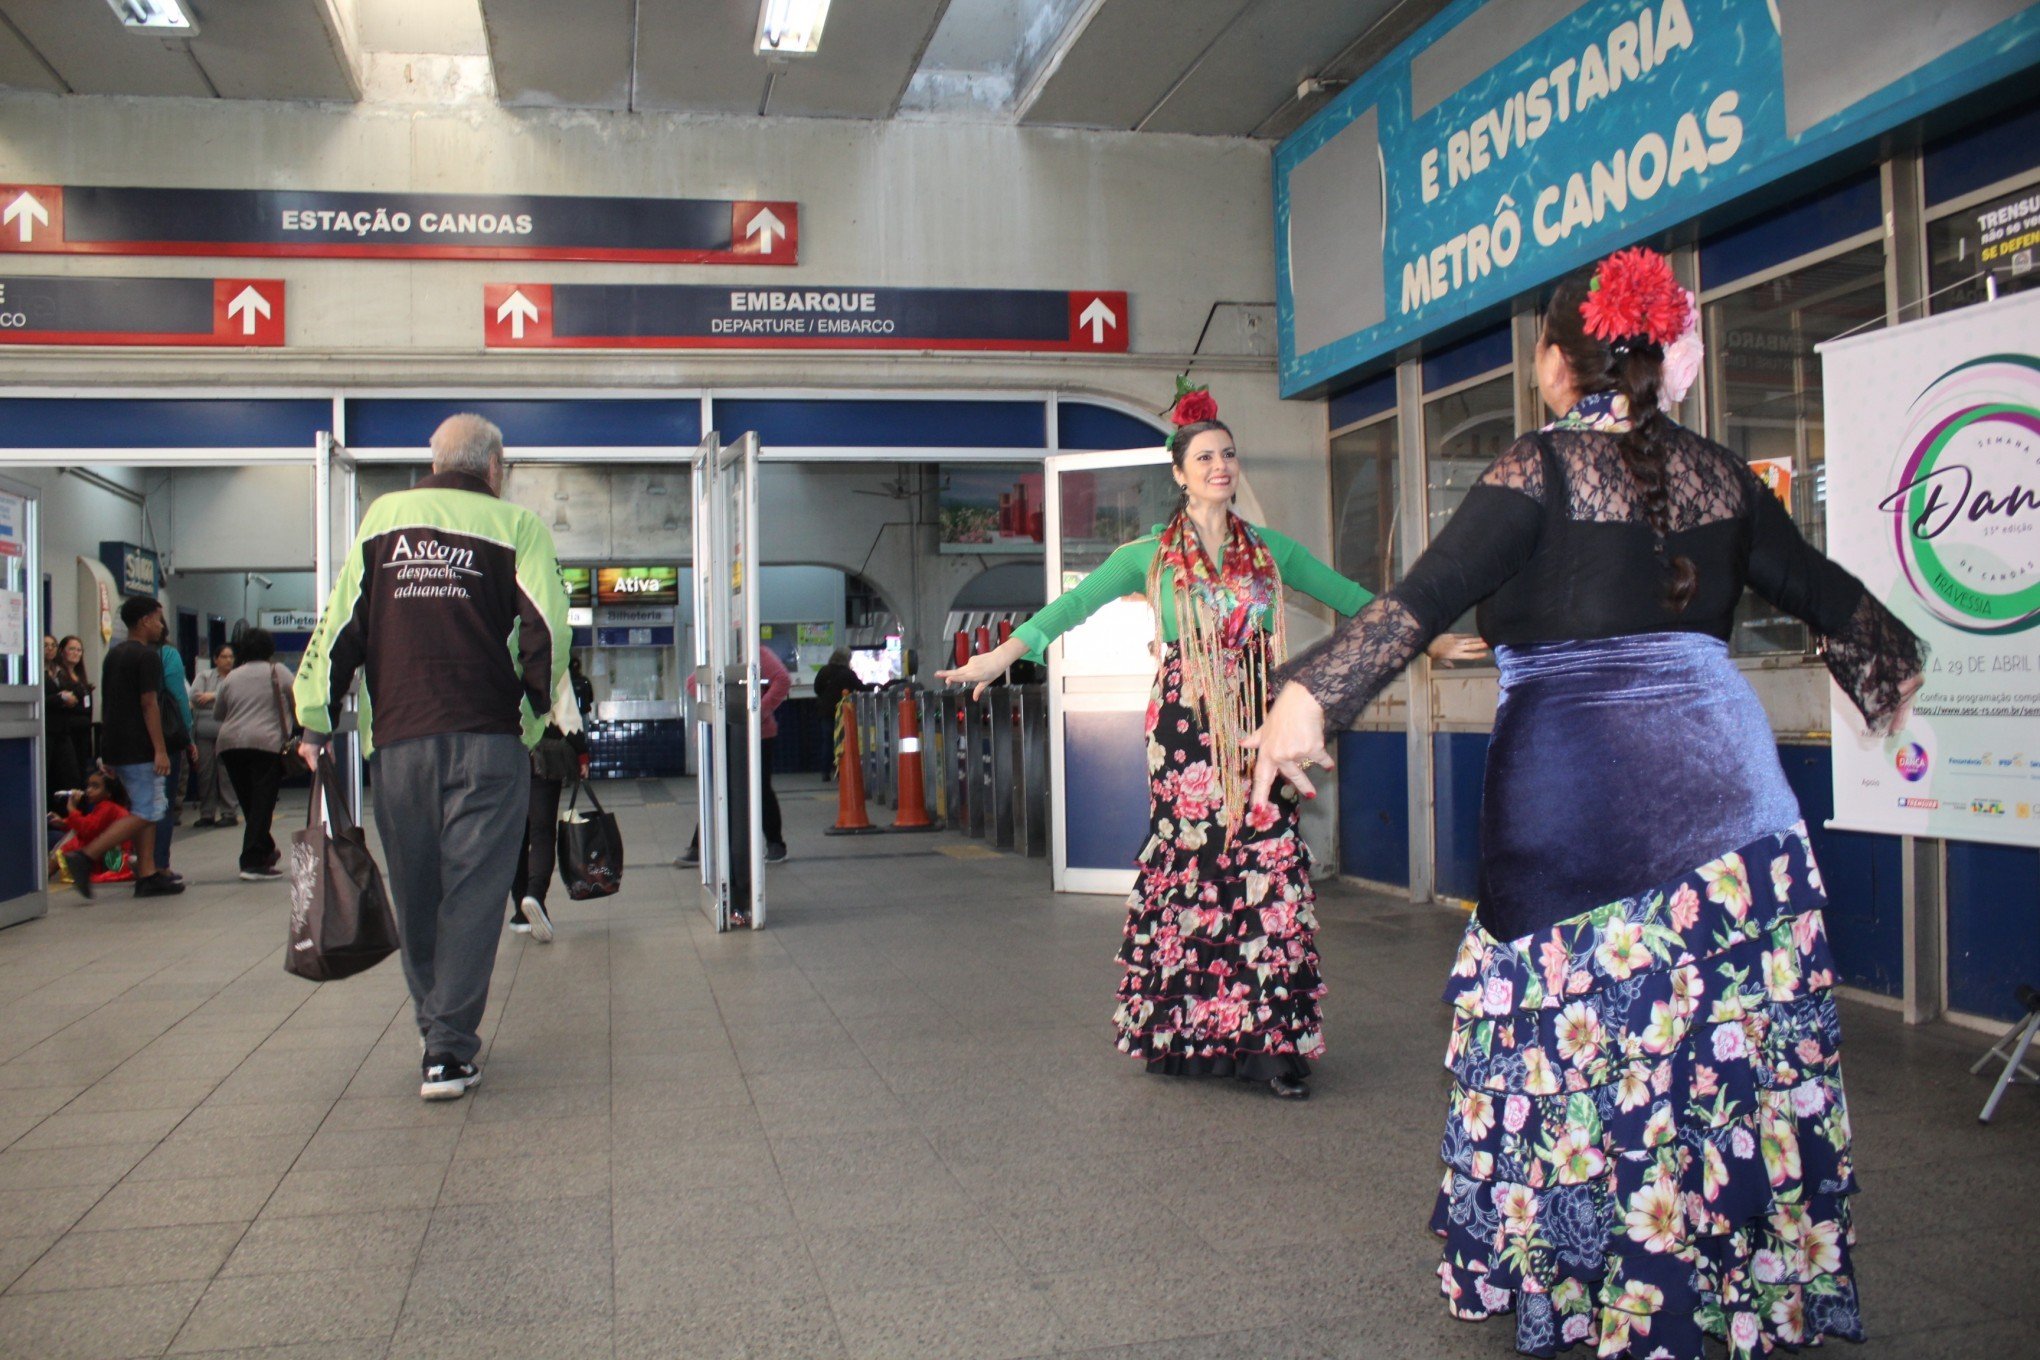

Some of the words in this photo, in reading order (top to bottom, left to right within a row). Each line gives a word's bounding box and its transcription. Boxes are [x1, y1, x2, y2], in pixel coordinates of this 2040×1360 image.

[1420, 148, 1440, 203] E
[1447, 0, 1695, 188] REVISTARIA
[1401, 194, 1522, 314] METRÔ
[1532, 90, 1744, 247] CANOAS
[282, 208, 411, 236] ESTAÇÃO
[419, 213, 533, 234] CANOAS
[1977, 195, 2040, 231] TRENSU
[1981, 245, 1998, 261] SE
[731, 292, 876, 313] EMBARQUE
[711, 319, 805, 333] DEPARTURE
[818, 320, 895, 333] EMBARCO
[391, 534, 474, 568] Ascam
[394, 582, 471, 599] aduaneiro
[614, 577, 661, 592] Ativa
[1968, 656, 1985, 673] DE
[1992, 655, 2032, 672] ABRIL
